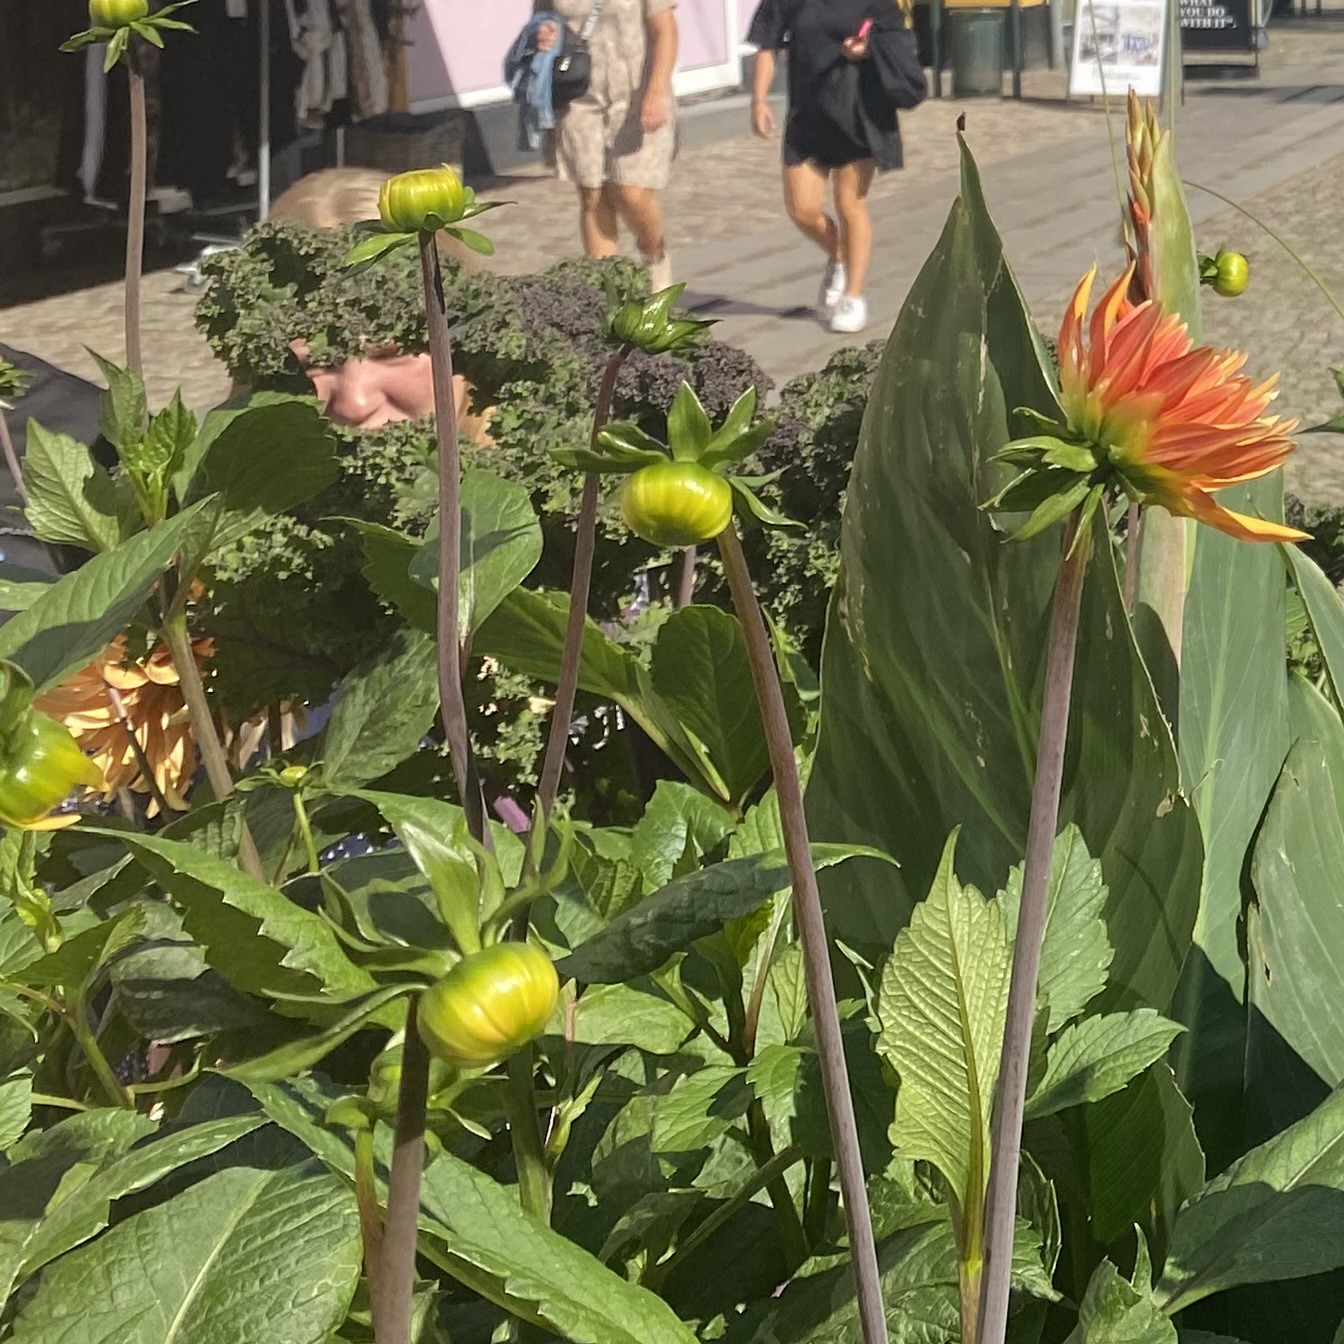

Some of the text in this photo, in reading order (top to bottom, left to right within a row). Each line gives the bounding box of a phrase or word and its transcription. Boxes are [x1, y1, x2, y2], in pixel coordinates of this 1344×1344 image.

[1179, 7, 1225, 17] YOU DO
[1179, 18, 1211, 28] WITH
